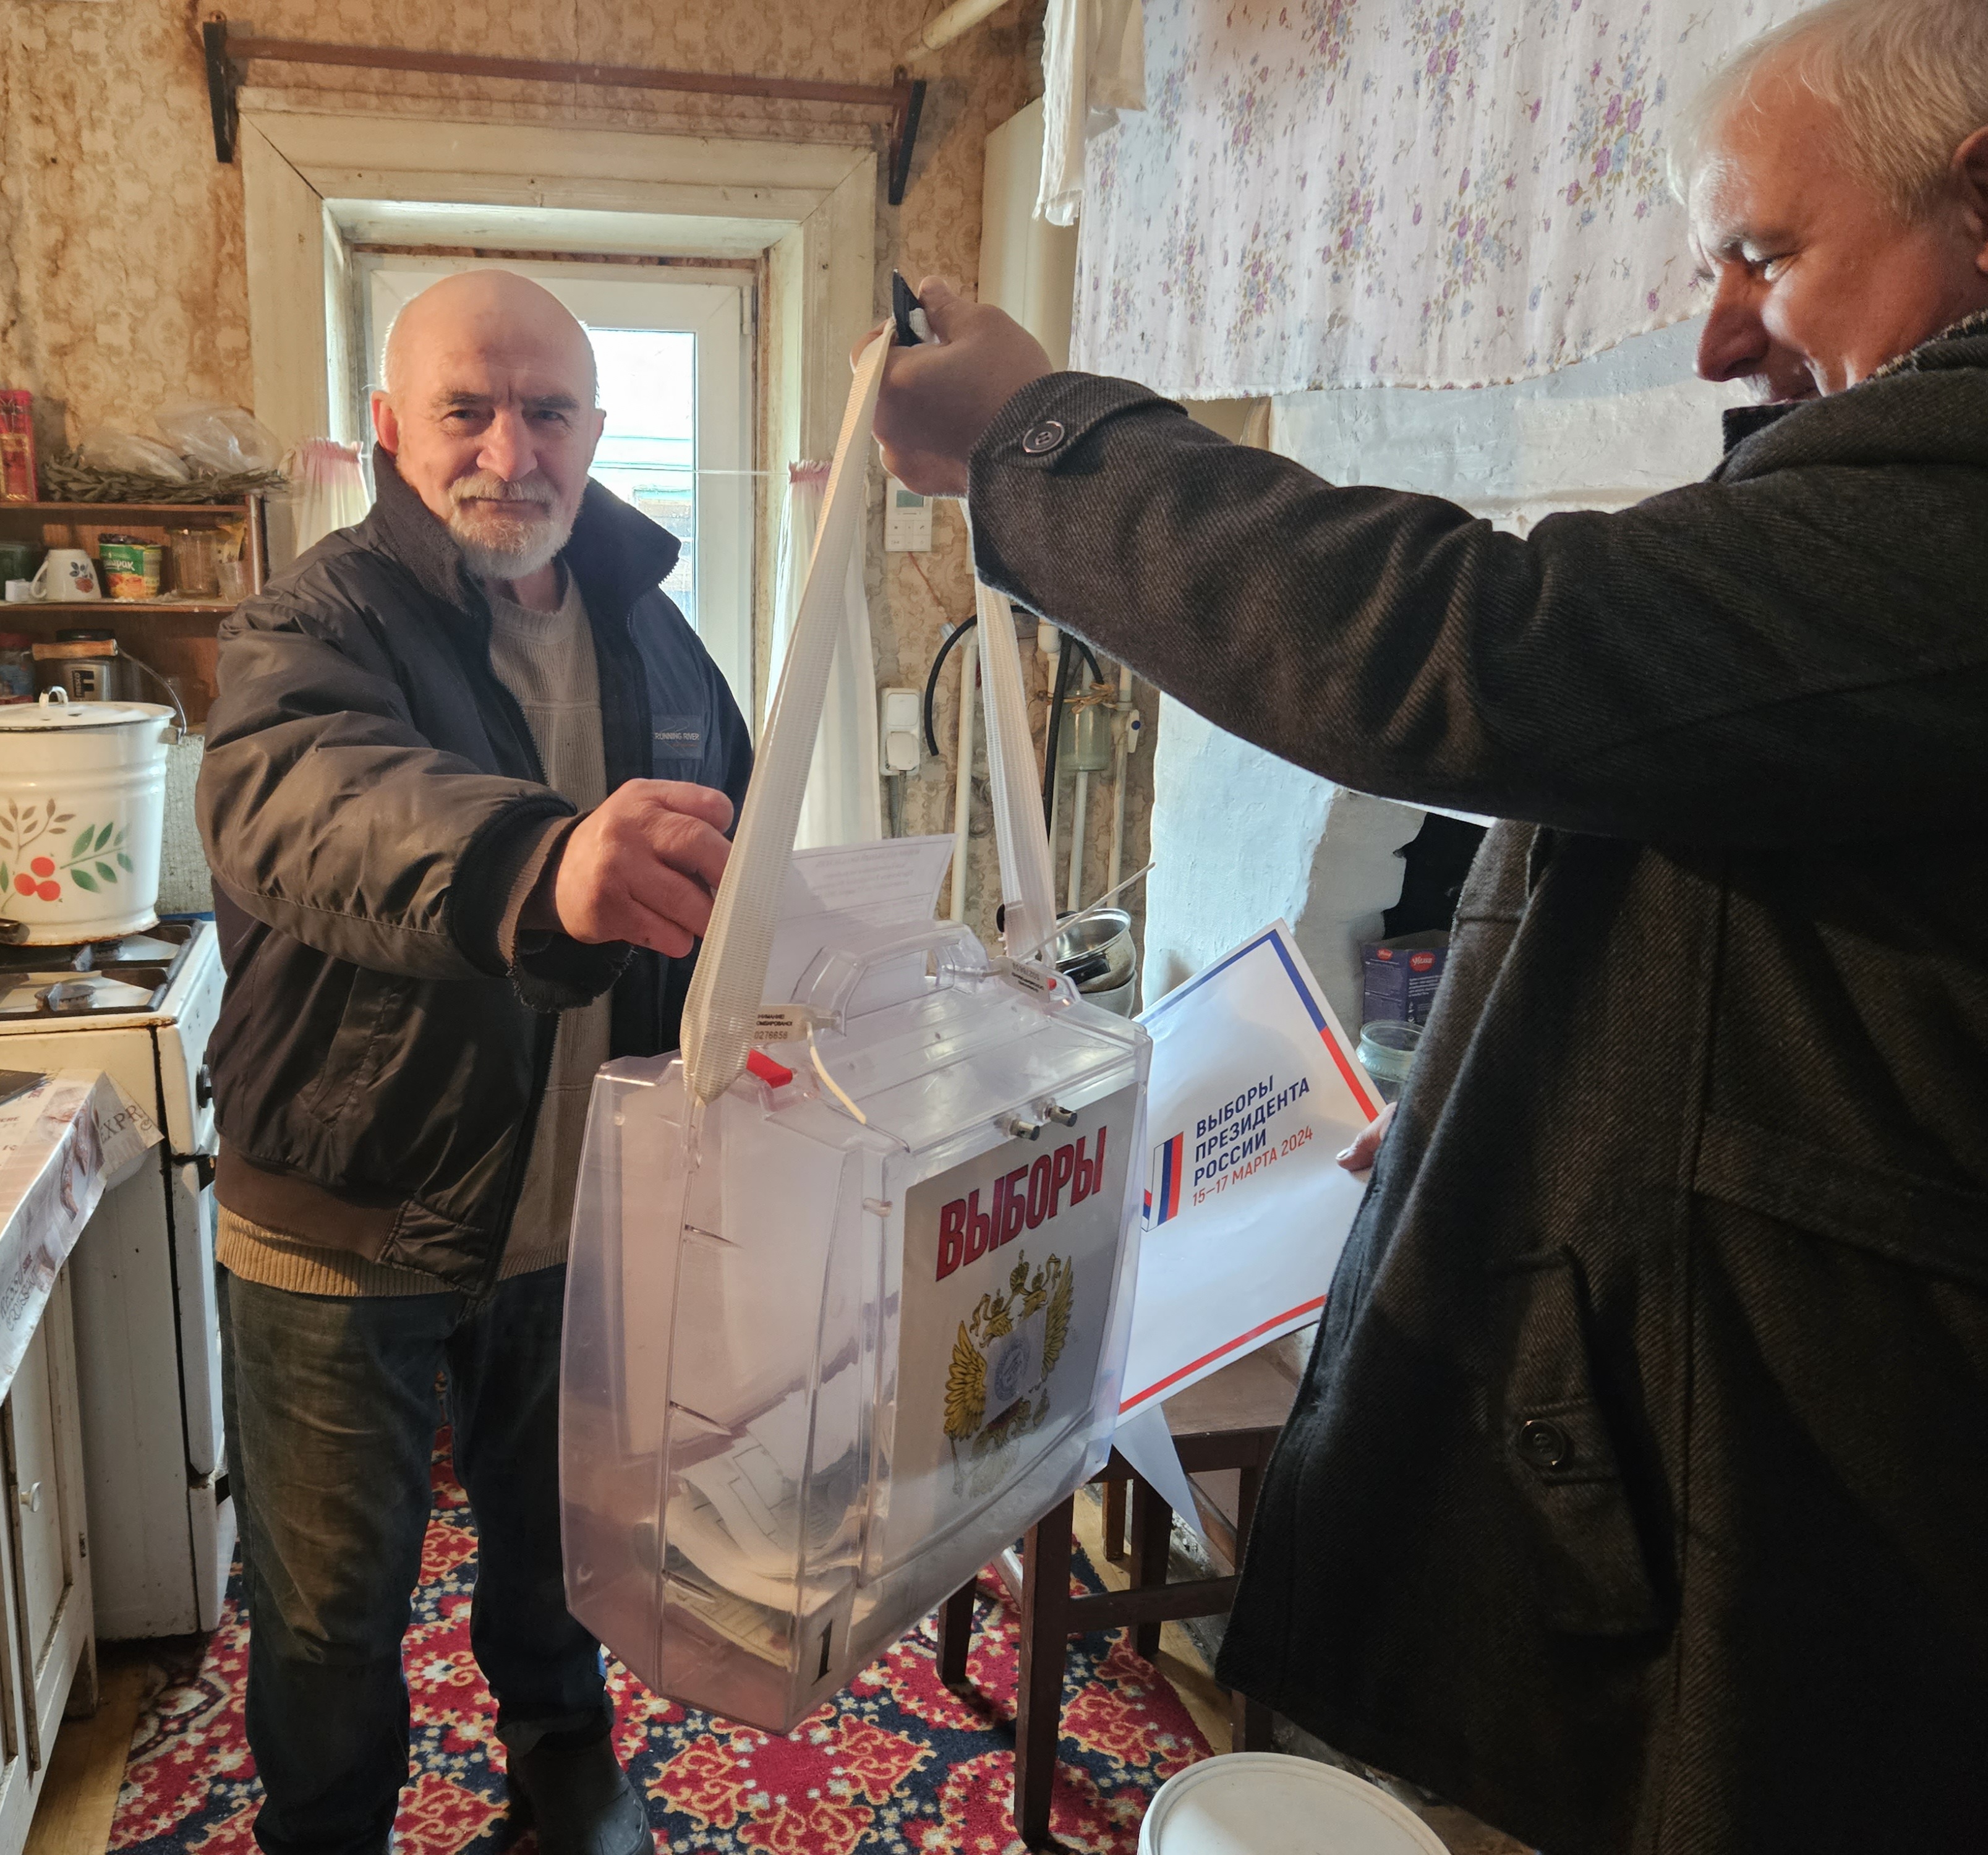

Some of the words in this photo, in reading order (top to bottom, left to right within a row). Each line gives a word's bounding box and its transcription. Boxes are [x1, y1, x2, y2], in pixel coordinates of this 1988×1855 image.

[655, 732, 681, 740] RUNNING
[1195, 1077, 1310, 1163] ПРЕЗИДЕНТА
[1196, 1075, 1274, 1139] ВЫБОРЫ
[1193, 1128, 1266, 1187] РОССИИ
[1232, 1153, 1278, 1186] МАРТА
[1281, 1125, 1313, 1157] 2024
[936, 1125, 1107, 1282] ВЫБОРЫ
[811, 1618, 833, 1686] 1
